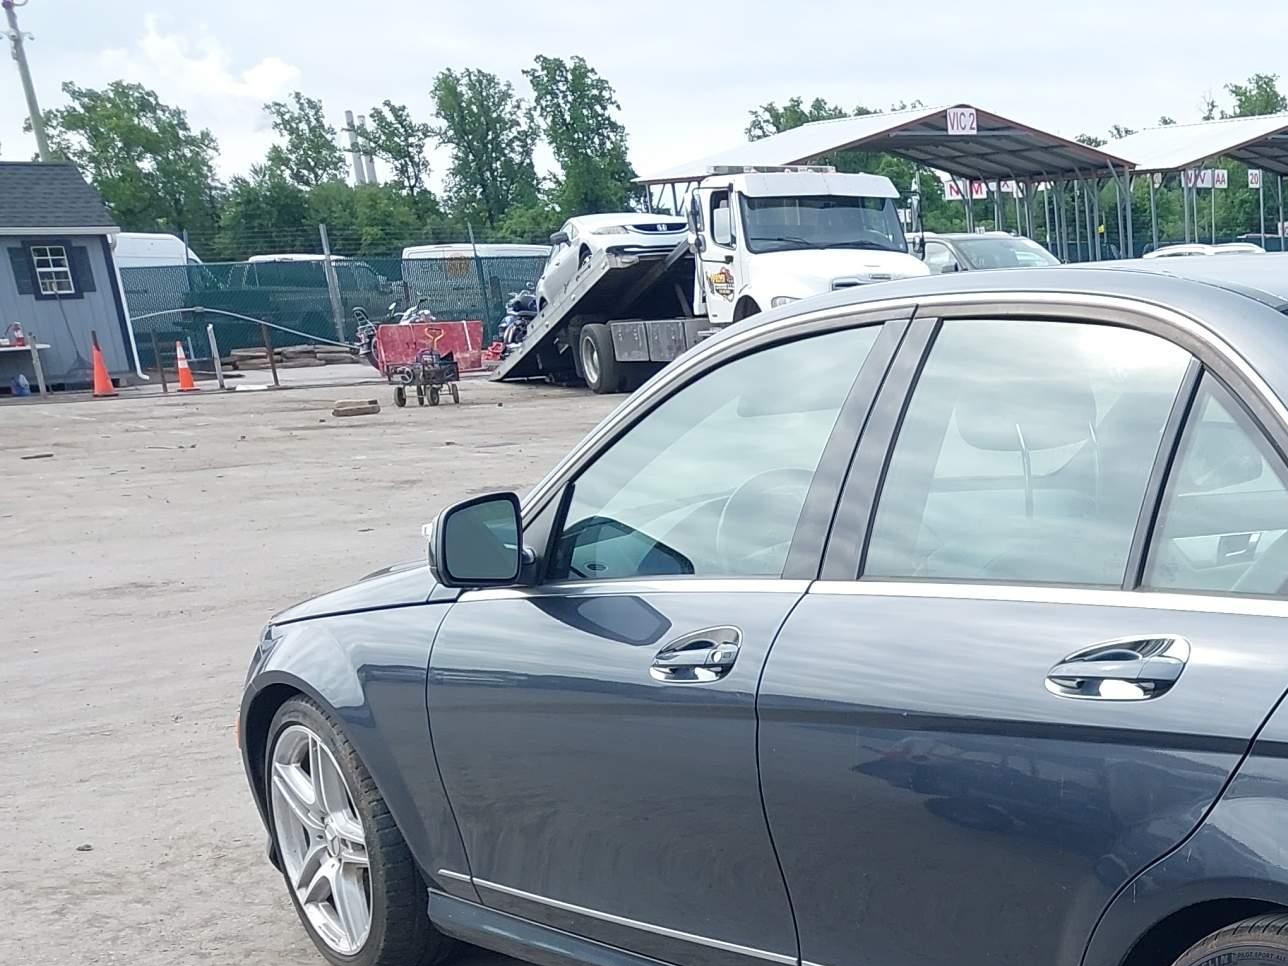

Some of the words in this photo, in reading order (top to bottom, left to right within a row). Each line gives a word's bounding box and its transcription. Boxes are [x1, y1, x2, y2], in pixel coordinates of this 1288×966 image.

[948, 112, 966, 130] VIC
[969, 113, 975, 130] 2
[1216, 174, 1226, 185] AA
[1249, 174, 1259, 185] 20
